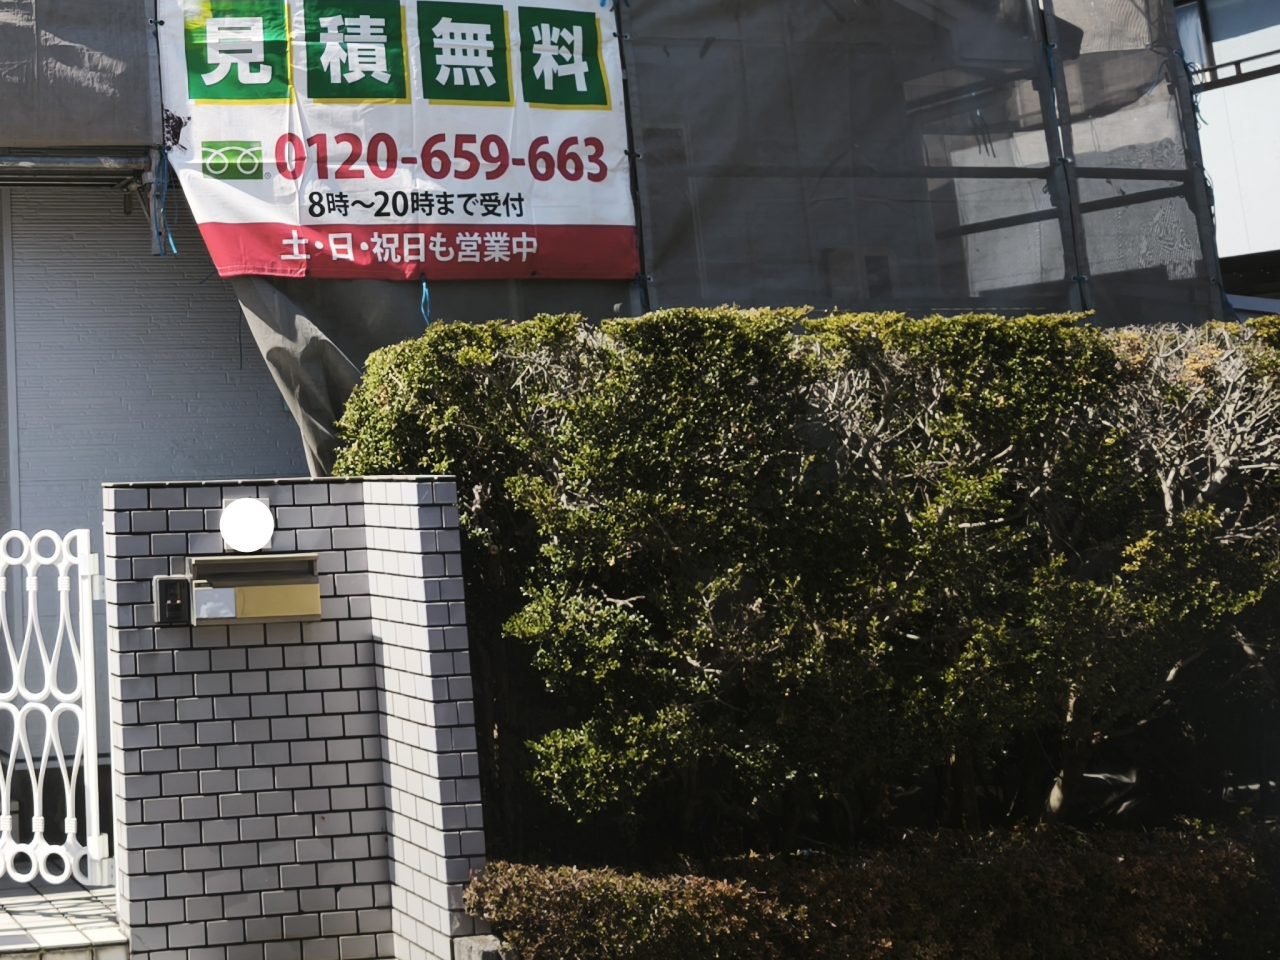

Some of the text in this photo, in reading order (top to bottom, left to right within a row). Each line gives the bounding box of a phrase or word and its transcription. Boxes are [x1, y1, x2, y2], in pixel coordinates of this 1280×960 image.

[200, 15, 590, 93] 見積無料
[274, 131, 609, 184] 0120-659-663
